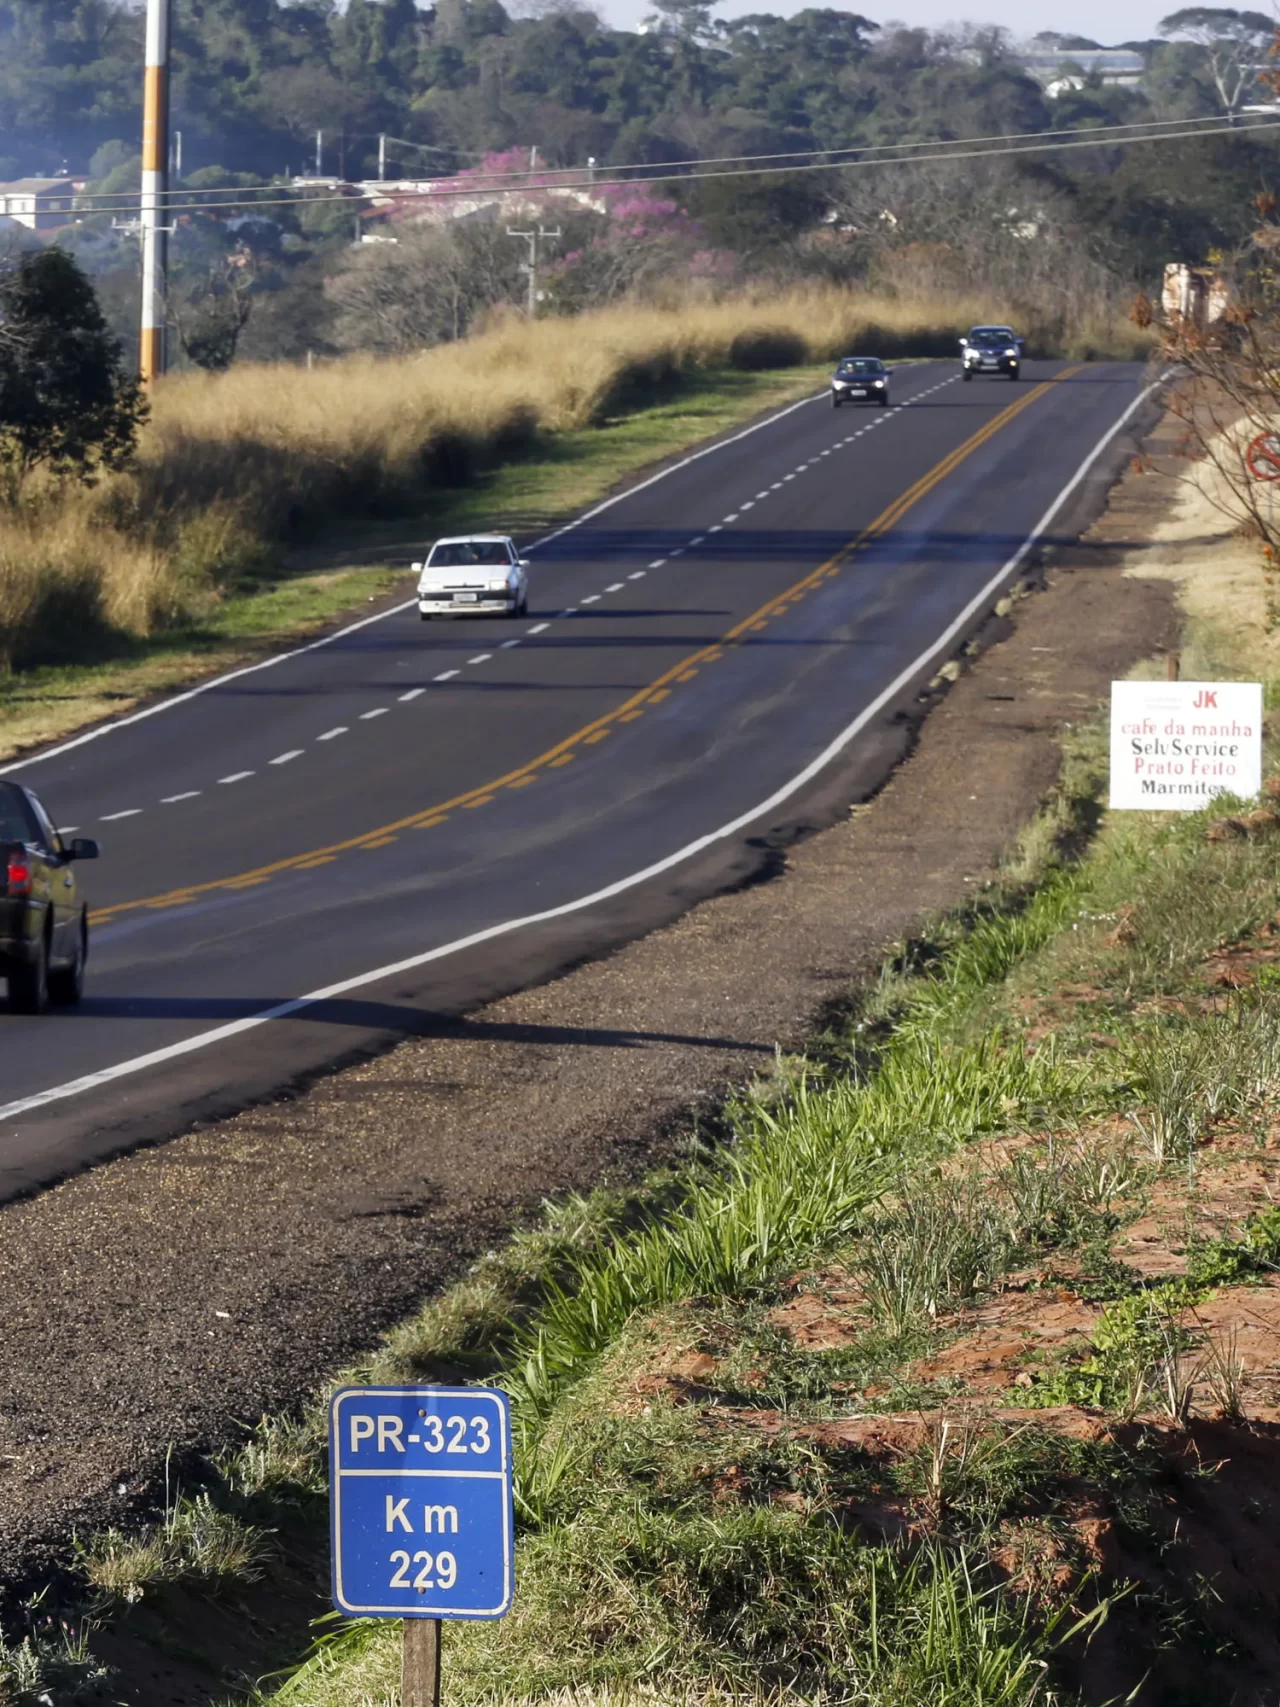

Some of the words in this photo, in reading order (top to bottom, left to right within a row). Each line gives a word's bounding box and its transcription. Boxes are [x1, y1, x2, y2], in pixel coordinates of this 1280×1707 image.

[1193, 690, 1218, 709] JK
[1164, 718, 1185, 736] da
[1192, 720, 1253, 738] manha
[1171, 738, 1239, 757] Service
[1134, 757, 1185, 775] Prato
[1191, 758, 1237, 776] Feito
[349, 1415, 492, 1454] PR-323
[389, 1549, 458, 1590] 229
